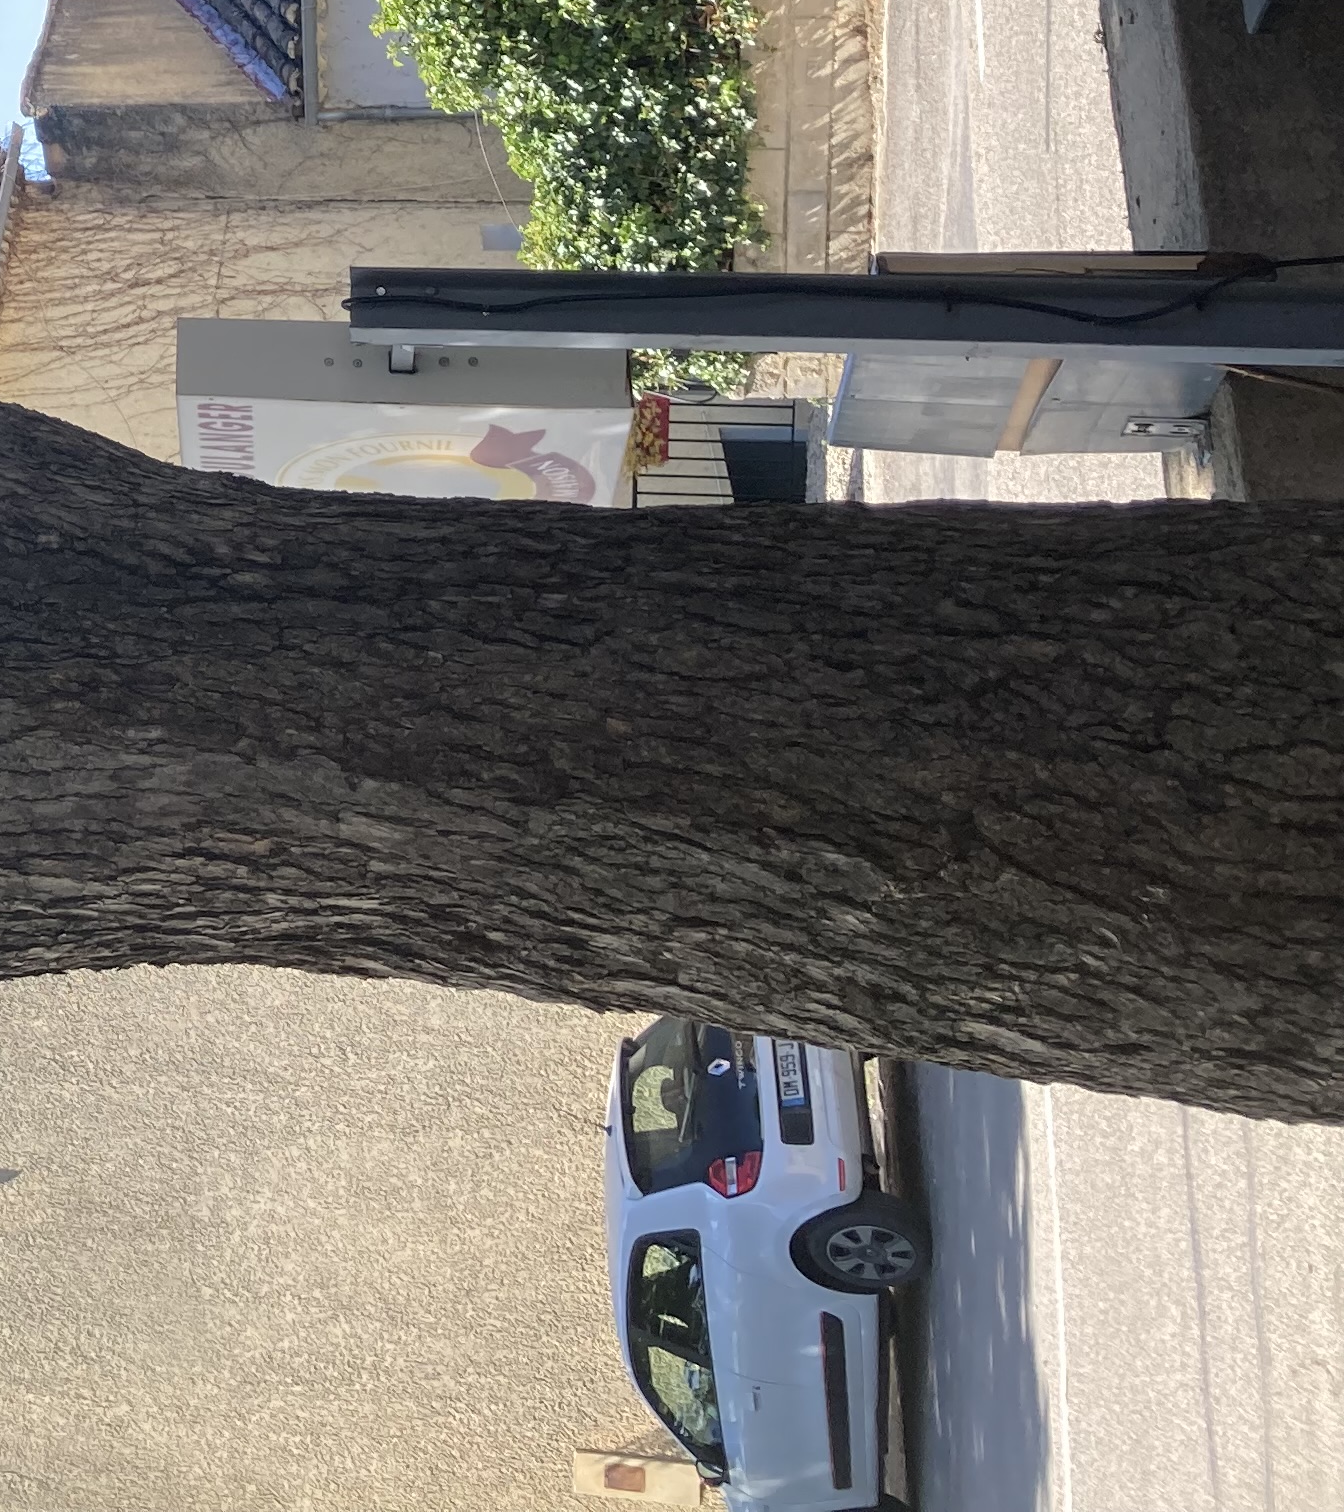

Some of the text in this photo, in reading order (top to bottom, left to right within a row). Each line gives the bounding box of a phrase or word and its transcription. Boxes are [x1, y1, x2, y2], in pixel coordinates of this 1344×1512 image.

[197, 403, 255, 478] ULANGER
[345, 439, 452, 460] FOURNIL
[528, 460, 579, 498] MAISON
[734, 1040, 746, 1090] TWINGO
[777, 1041, 800, 1097] DM-959-J
